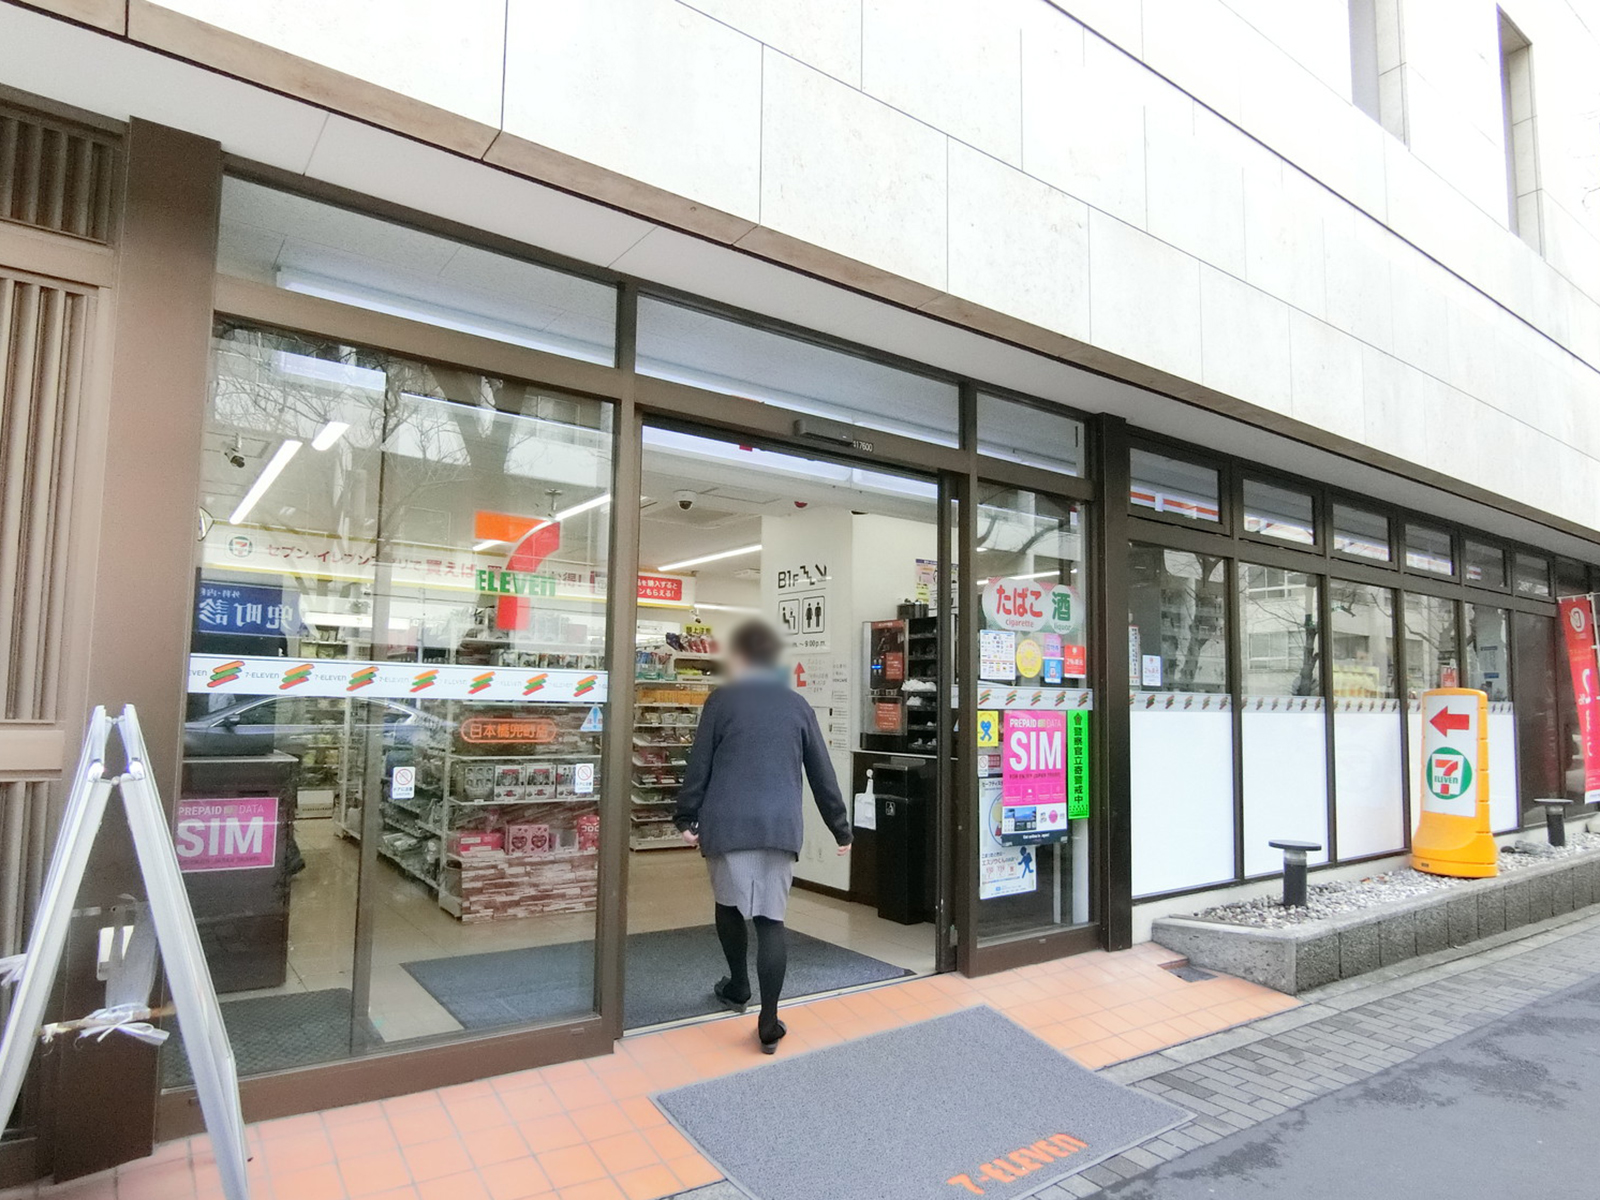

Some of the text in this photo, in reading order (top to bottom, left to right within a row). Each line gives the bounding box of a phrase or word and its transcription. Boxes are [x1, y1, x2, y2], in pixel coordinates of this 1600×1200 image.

[996, 585, 1043, 617] たばこ
[1052, 592, 1071, 621] 酒
[1009, 718, 1037, 728] PREPAID
[1009, 731, 1062, 772] SIM
[179, 805, 264, 816] PREPAID DATA
[176, 816, 264, 858] SIM
